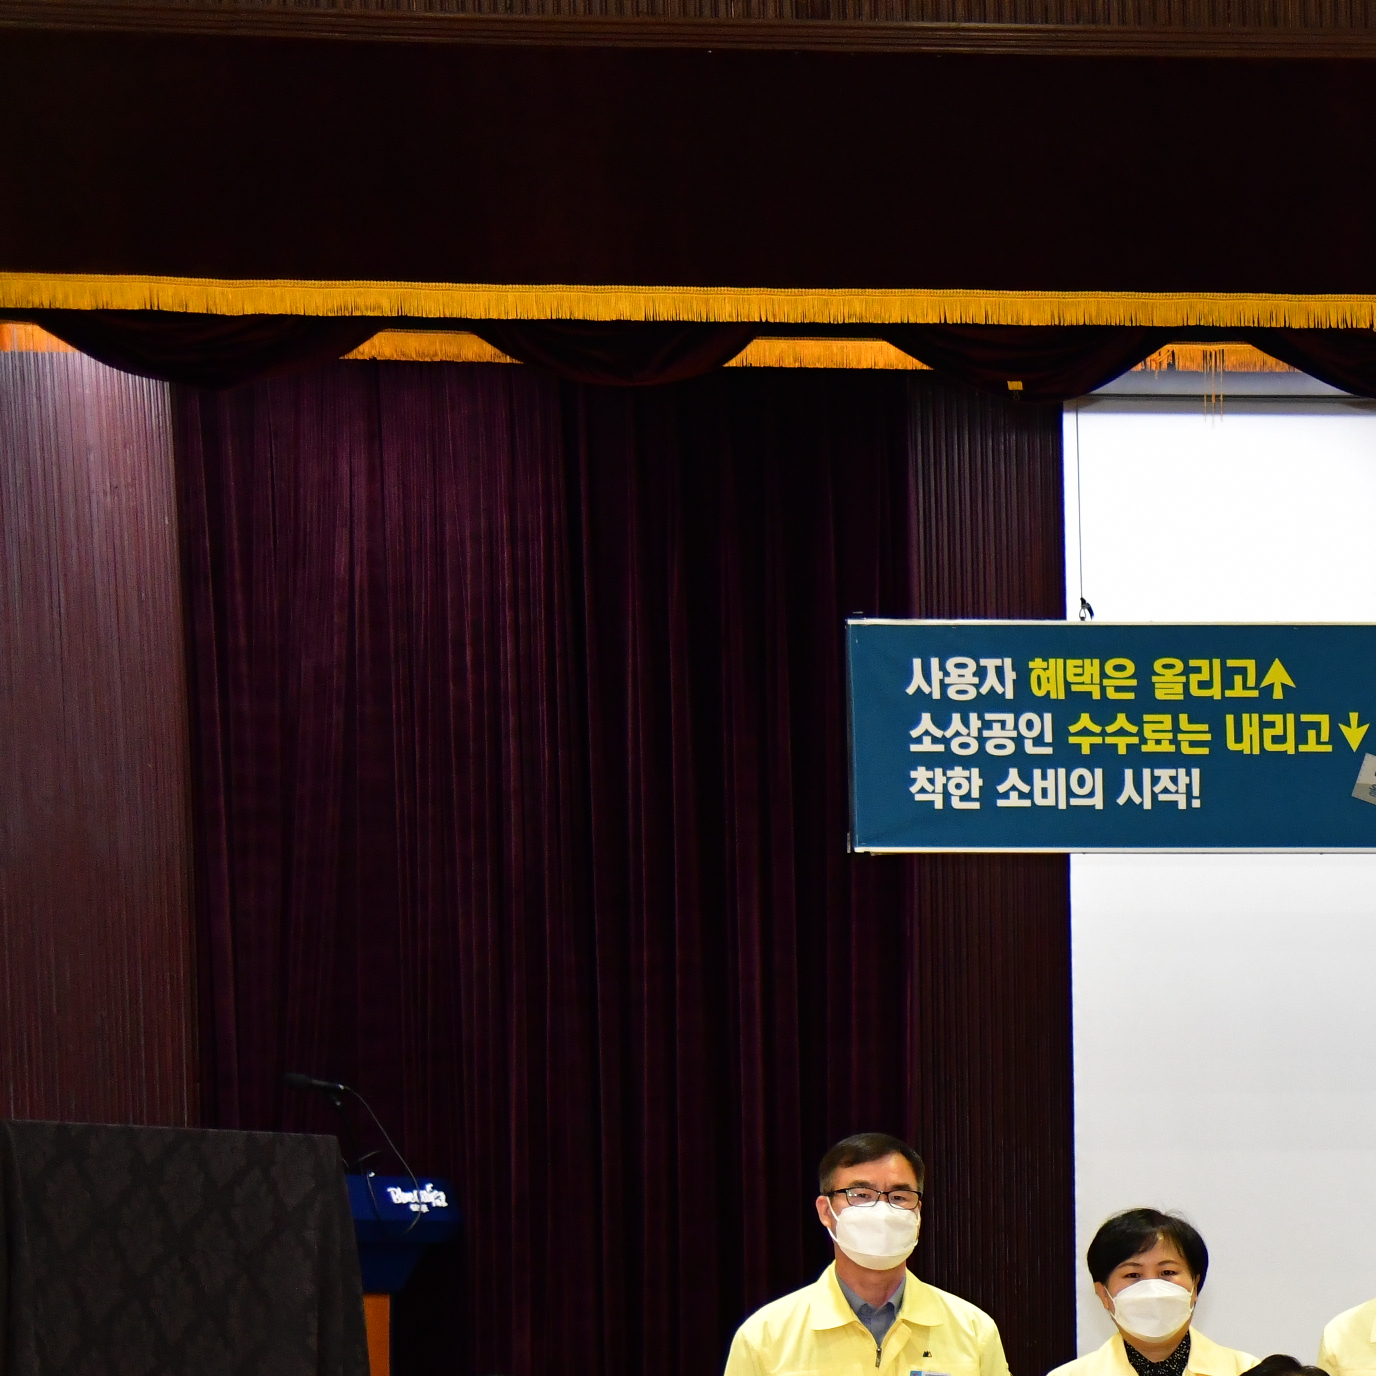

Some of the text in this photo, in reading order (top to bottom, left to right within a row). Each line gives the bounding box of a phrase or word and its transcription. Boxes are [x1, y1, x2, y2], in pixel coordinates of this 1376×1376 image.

[906, 657, 1260, 700] 사용자 혜택은 올리고
[909, 712, 1333, 755] 소상공인 수수료는 내리고
[909, 767, 1201, 810] 착한 소비의 시작!
